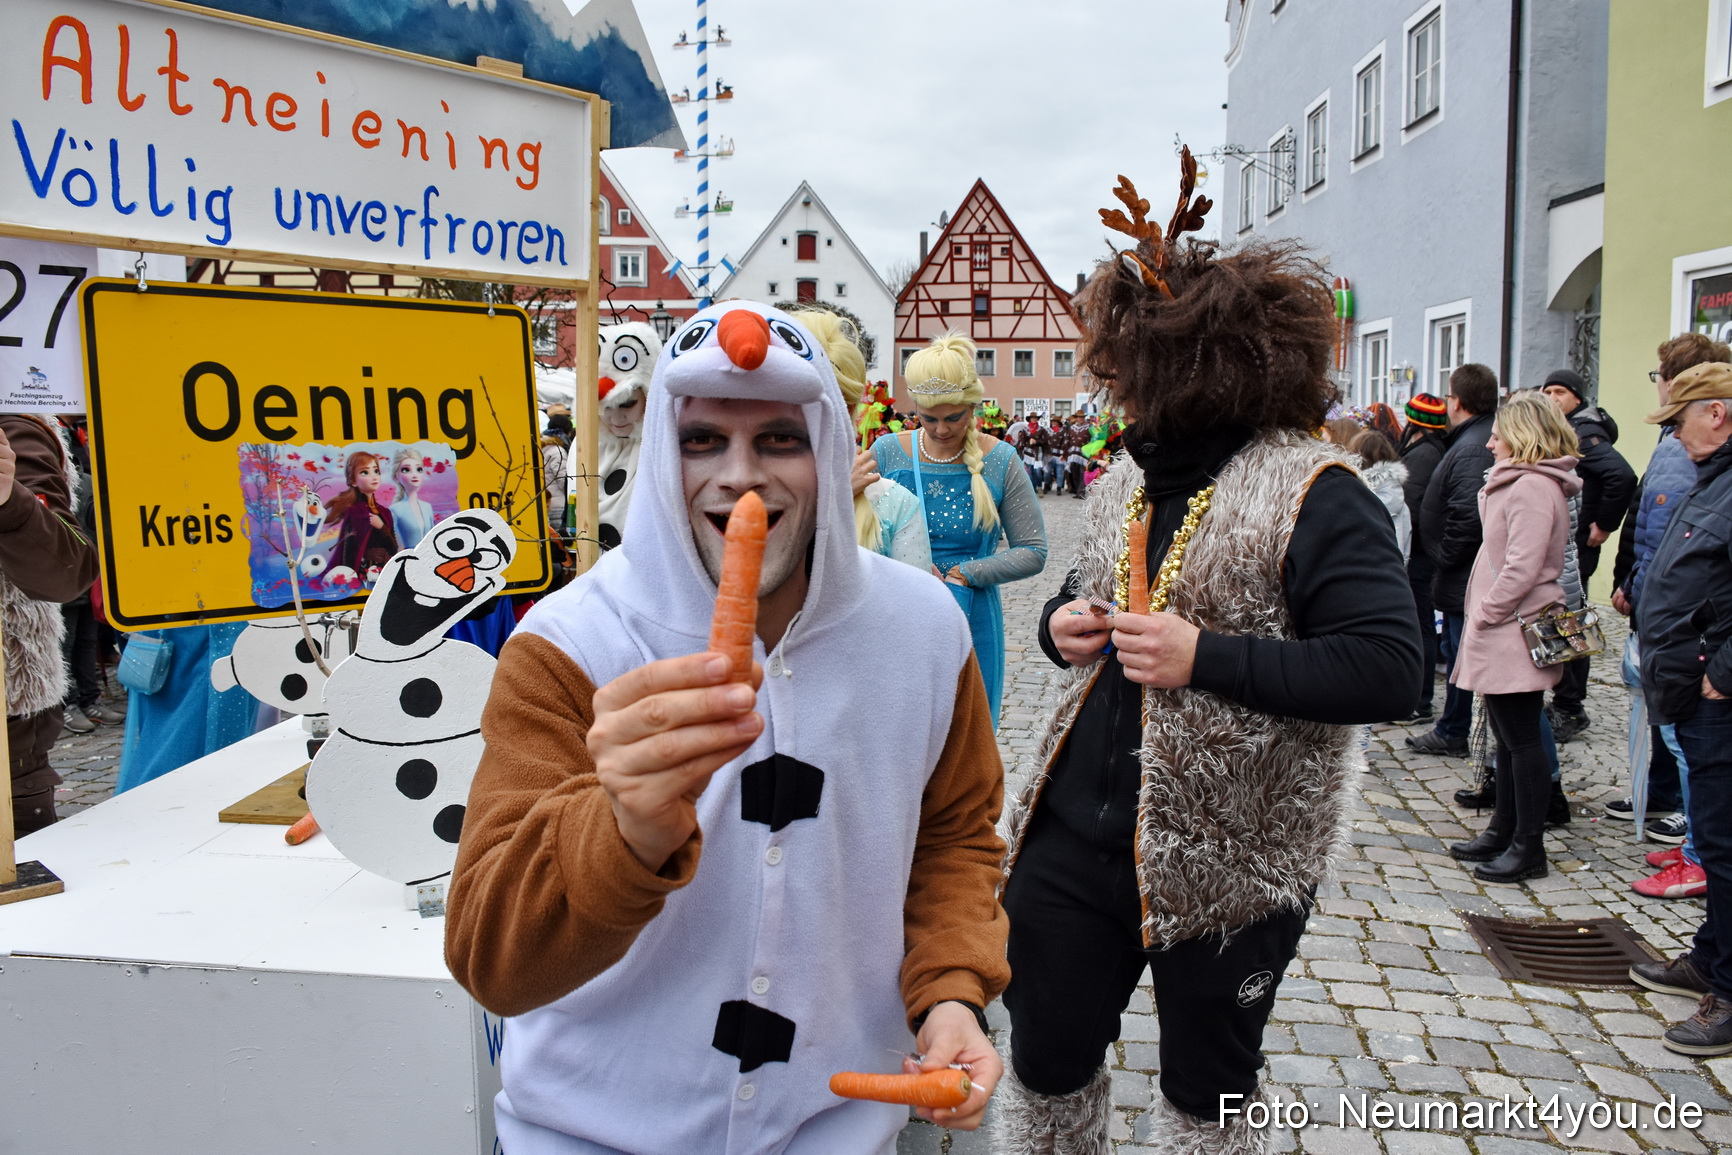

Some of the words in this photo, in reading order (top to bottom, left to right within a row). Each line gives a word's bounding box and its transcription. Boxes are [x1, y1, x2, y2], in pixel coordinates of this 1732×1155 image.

[42, 15, 542, 190] Altneiening
[12, 119, 233, 246] Völlig
[274, 186, 568, 267] unverfroren
[10, 392, 63, 400] Faschingsumzug
[38, 399, 66, 407] Berching
[182, 361, 477, 459] Oening
[140, 503, 233, 547] Kreis
